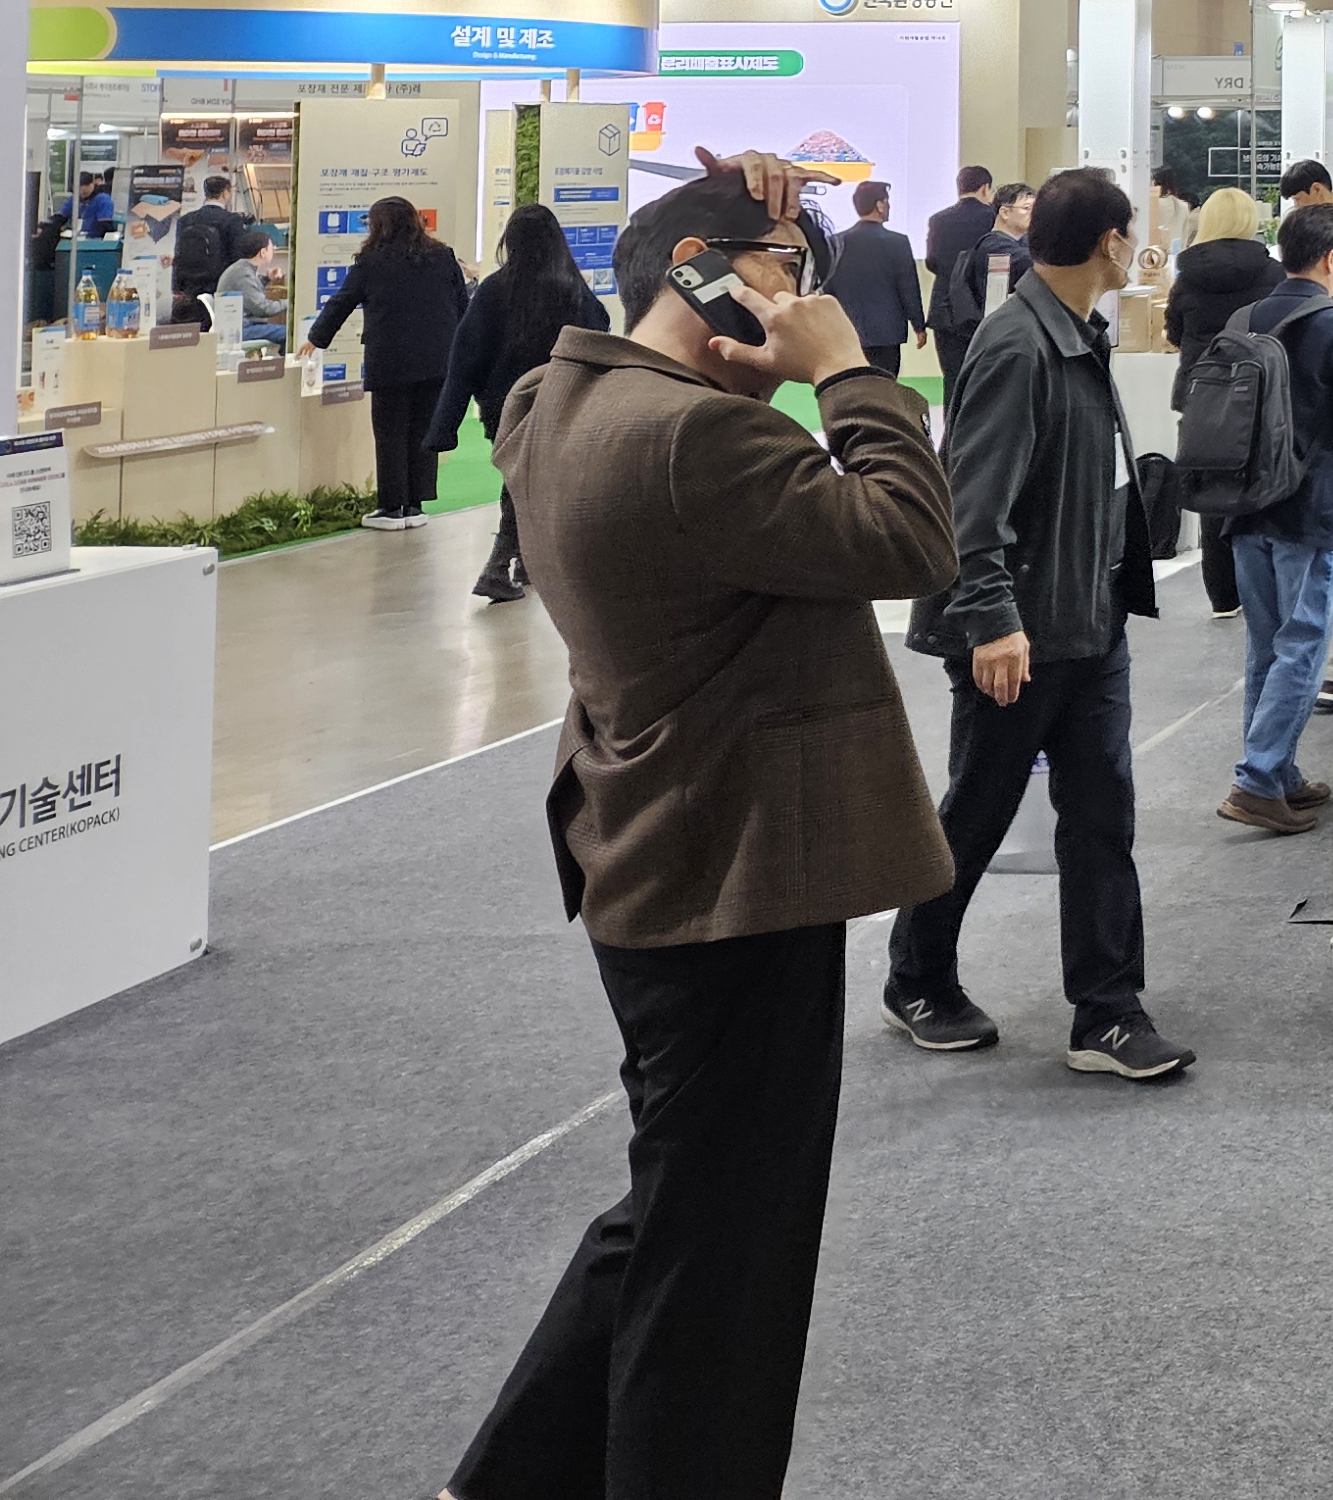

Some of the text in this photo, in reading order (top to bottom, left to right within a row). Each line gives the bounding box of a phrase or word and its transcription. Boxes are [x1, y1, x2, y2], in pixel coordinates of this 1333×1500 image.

[450, 25, 555, 50] 설계 및 제조
[660, 56, 779, 71] 분리배출표시제도
[18, 806, 121, 854] CENTER(KOPACK)
